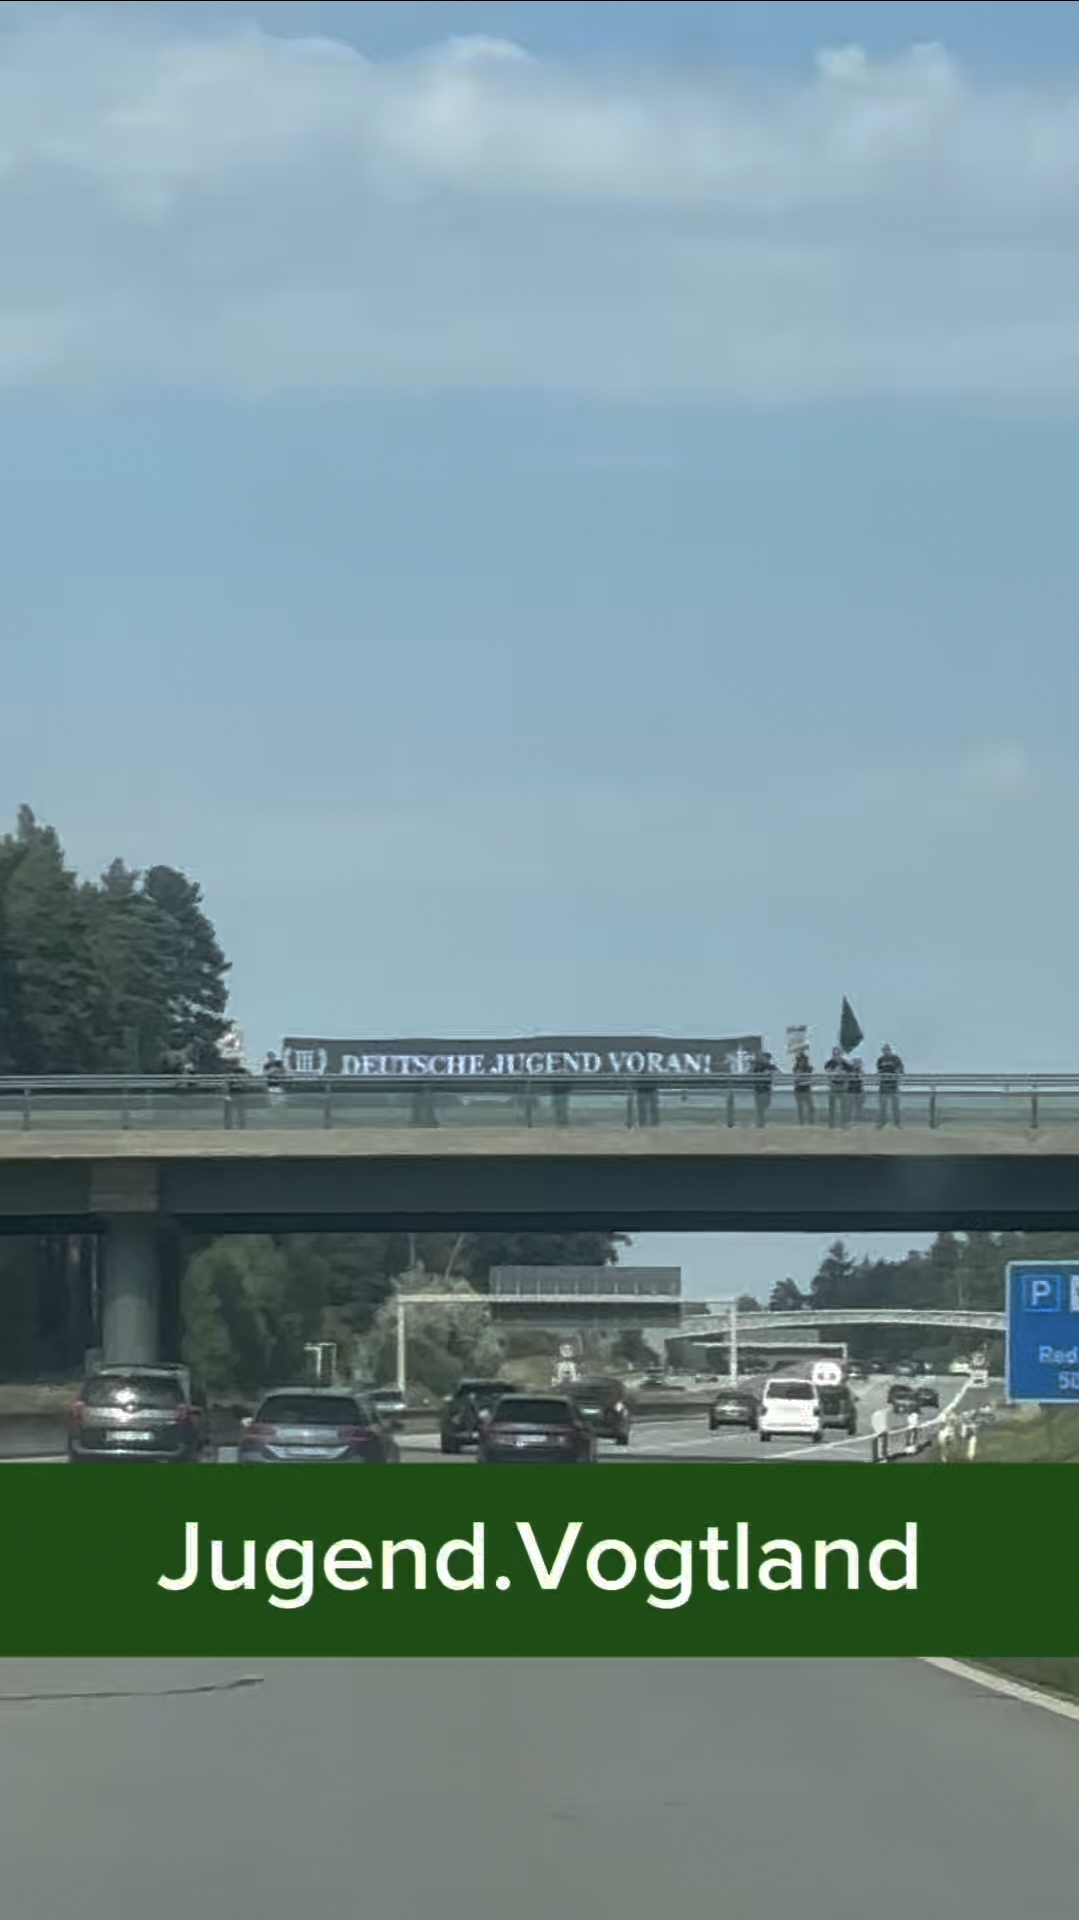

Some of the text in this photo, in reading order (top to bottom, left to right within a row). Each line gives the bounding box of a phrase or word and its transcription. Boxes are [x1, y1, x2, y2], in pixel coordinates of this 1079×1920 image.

[342, 1053, 711, 1074] DEUTSCHE JUGEND VORAN!
[1030, 1280, 1051, 1306] P
